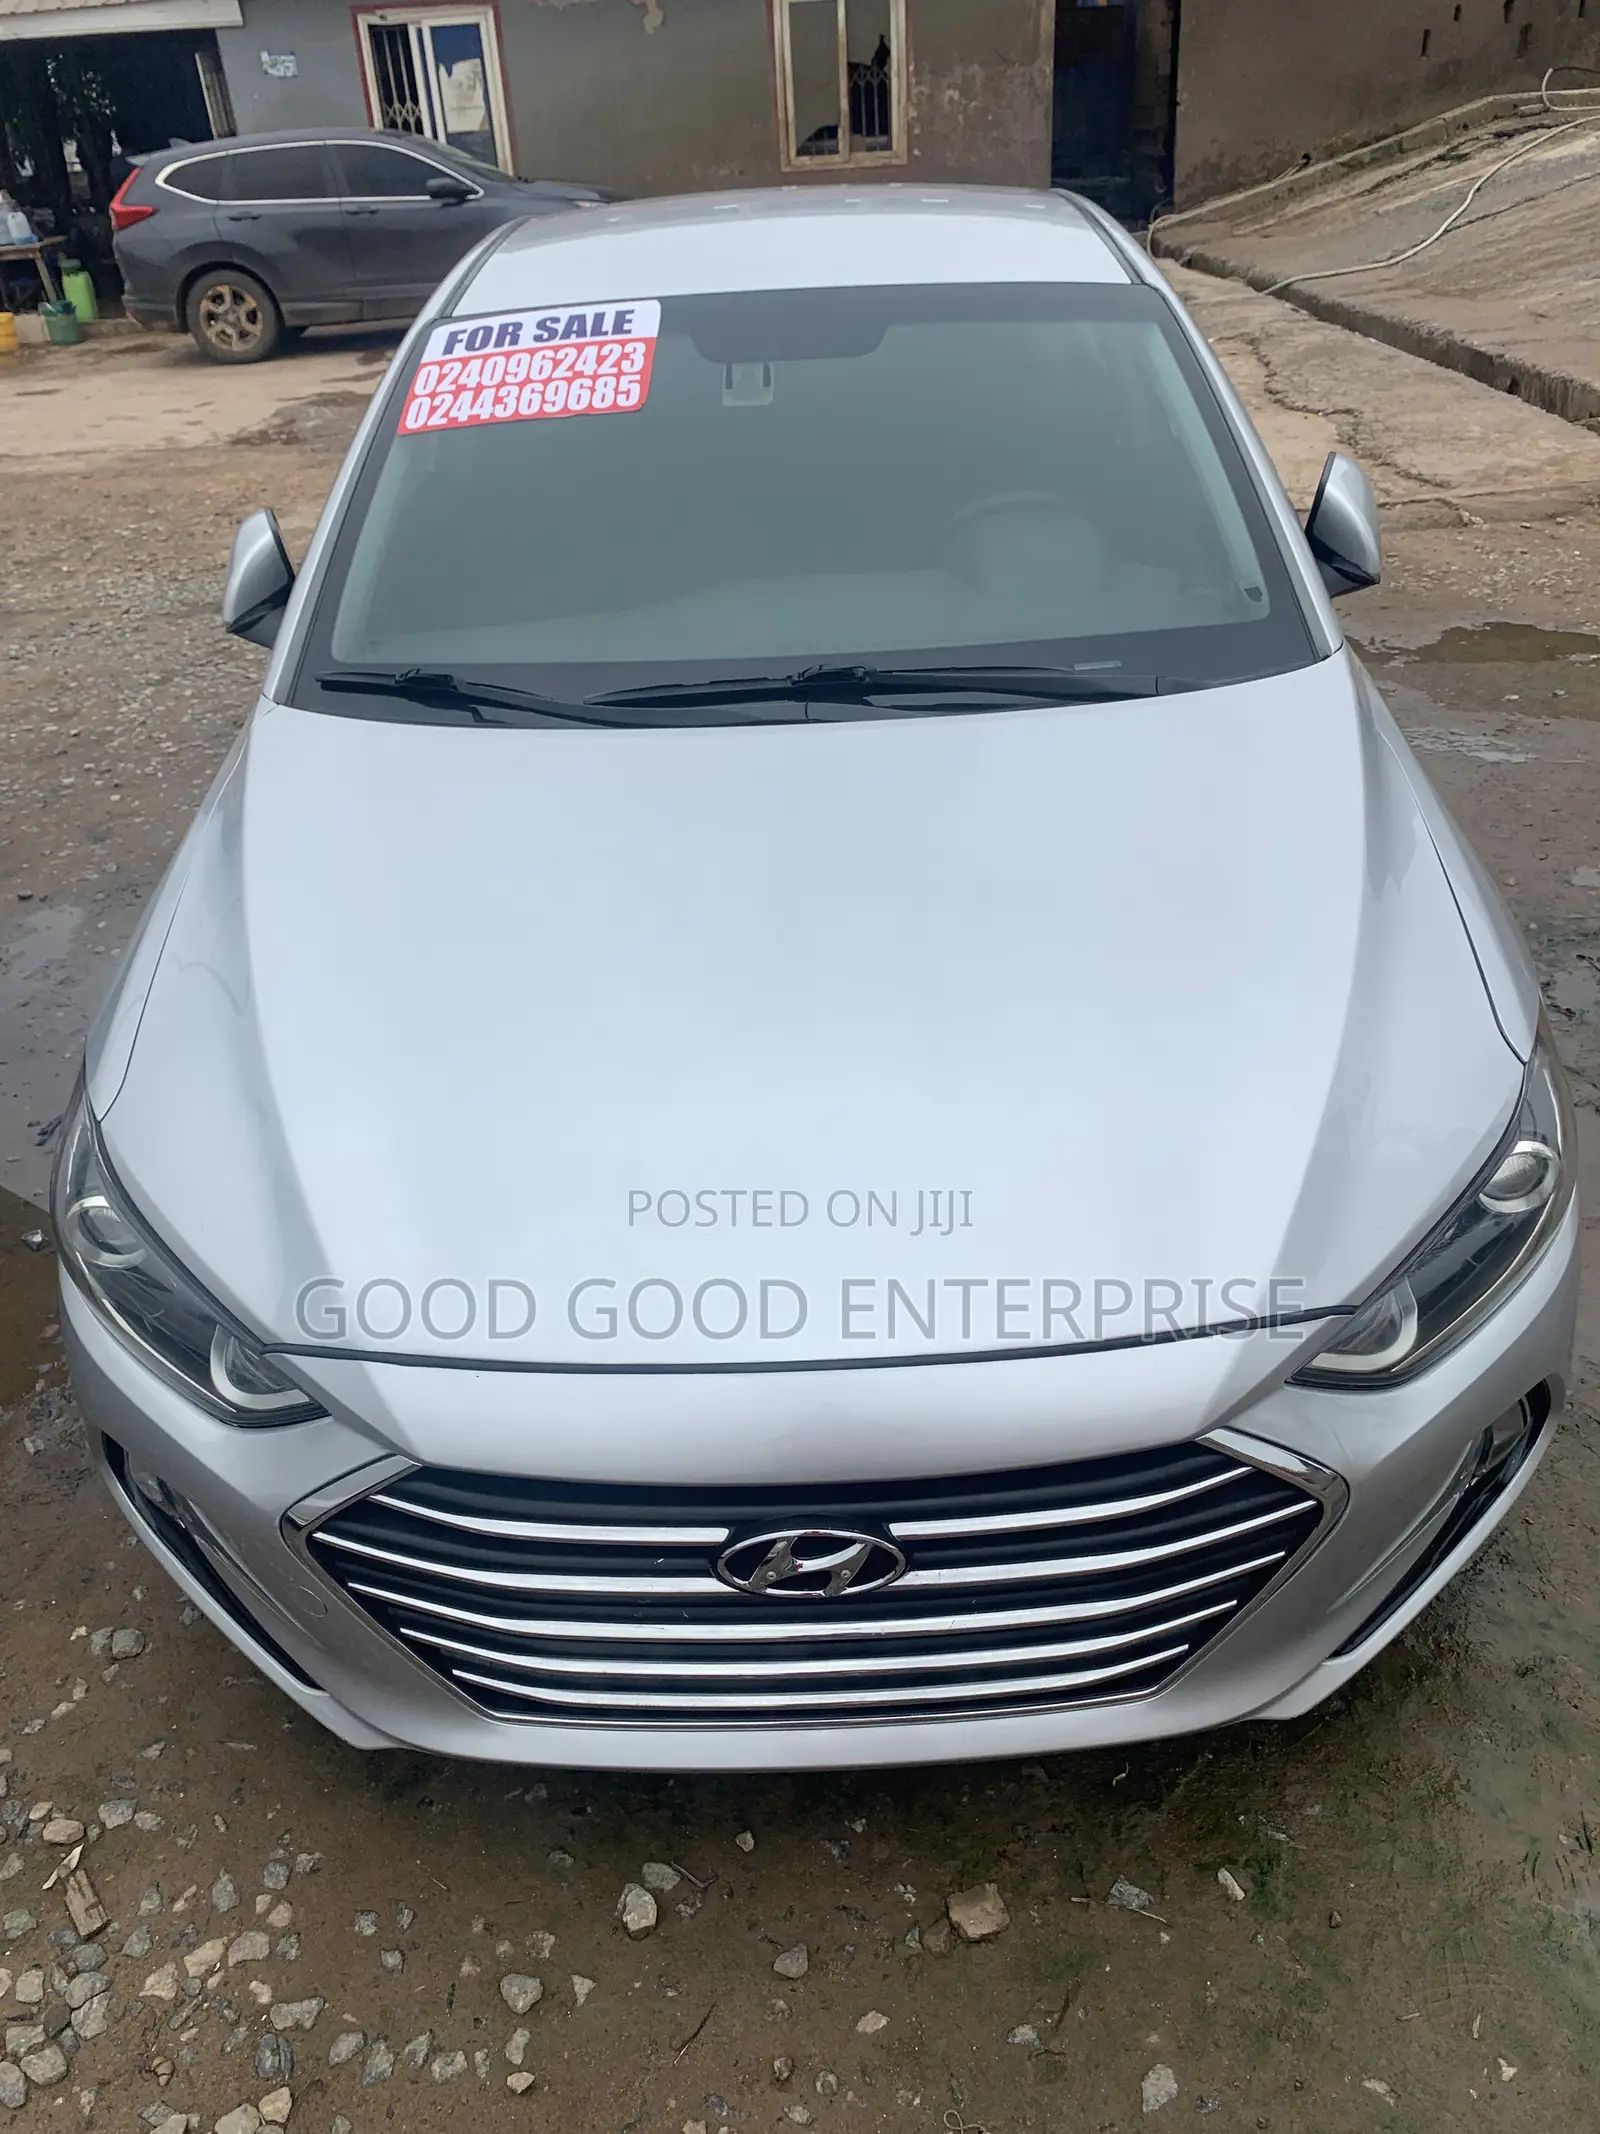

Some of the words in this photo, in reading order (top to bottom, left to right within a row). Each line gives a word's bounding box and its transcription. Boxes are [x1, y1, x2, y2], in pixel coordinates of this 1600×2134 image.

[442, 321, 523, 356] FOR
[533, 309, 635, 342] SALE
[414, 341, 646, 396] 0240962423
[405, 374, 641, 429] 0244369685
